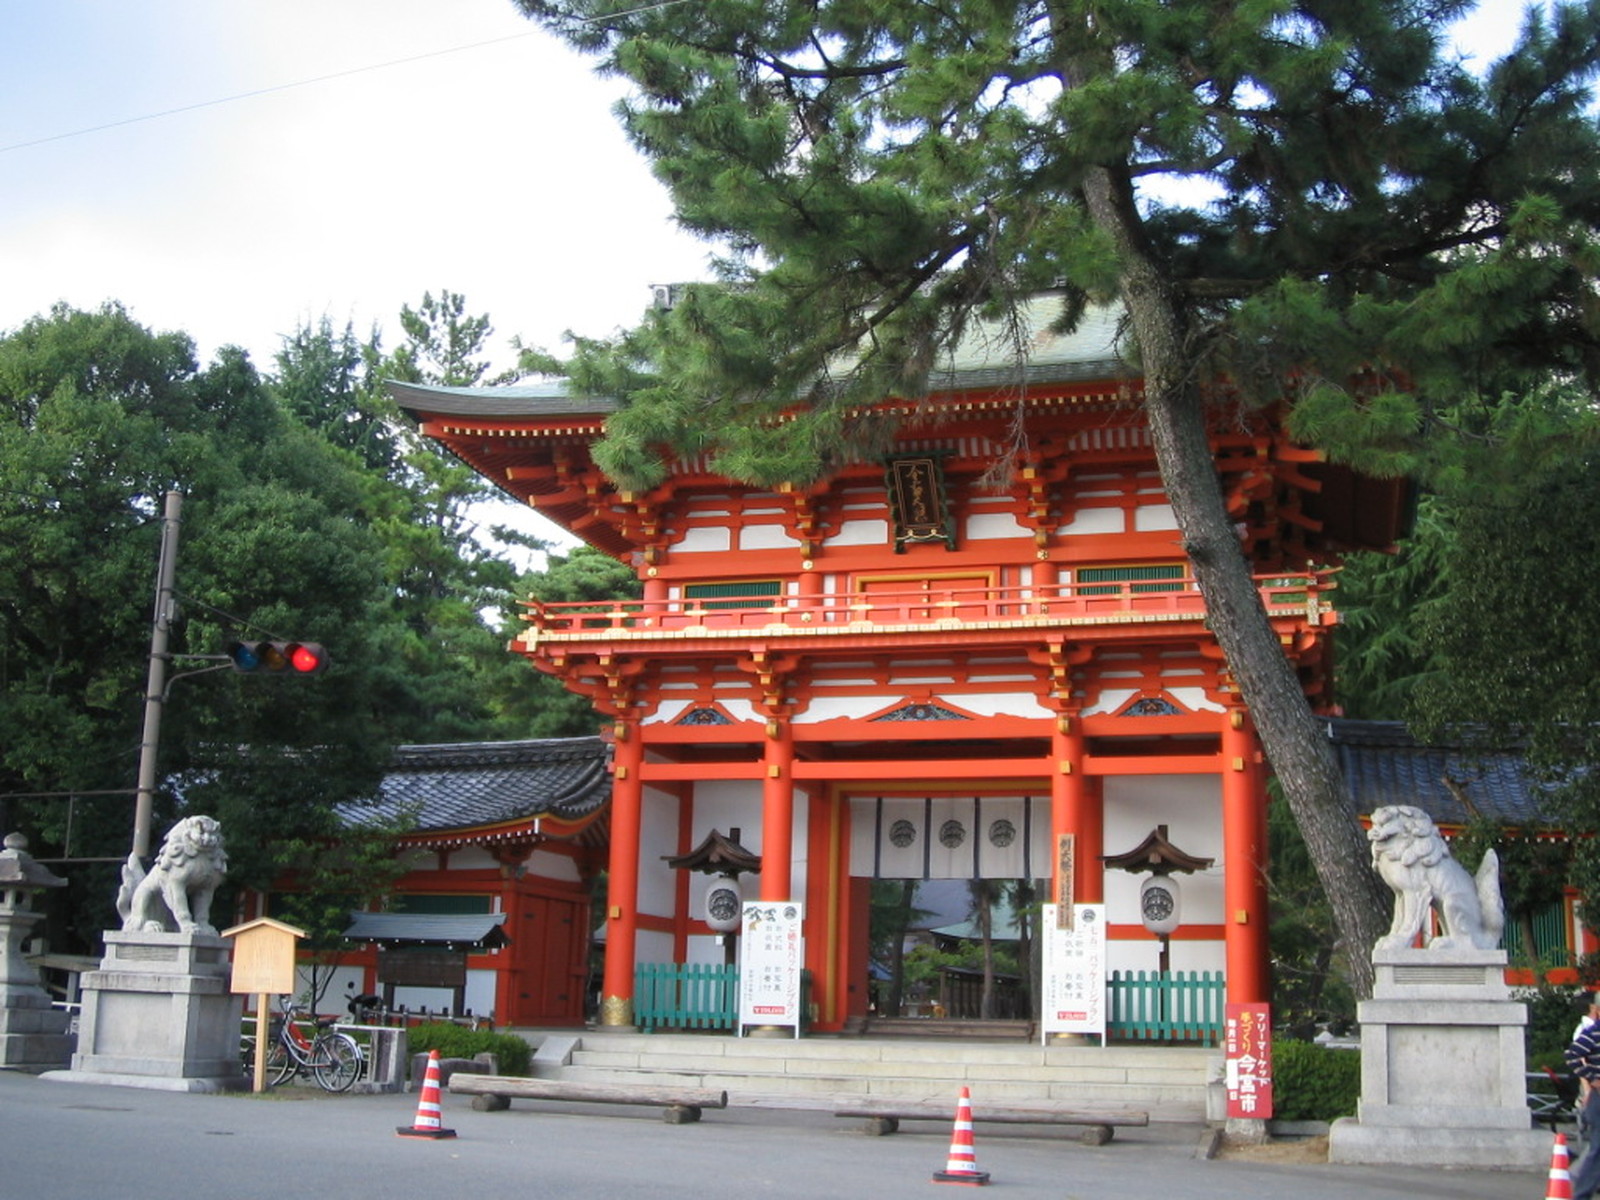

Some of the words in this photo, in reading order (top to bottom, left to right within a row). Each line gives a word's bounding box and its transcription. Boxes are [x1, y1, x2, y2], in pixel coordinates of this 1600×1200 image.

[1238, 1054, 1257, 1112] 今宮市
[1256, 1013, 1268, 1087] フリーマーケット
